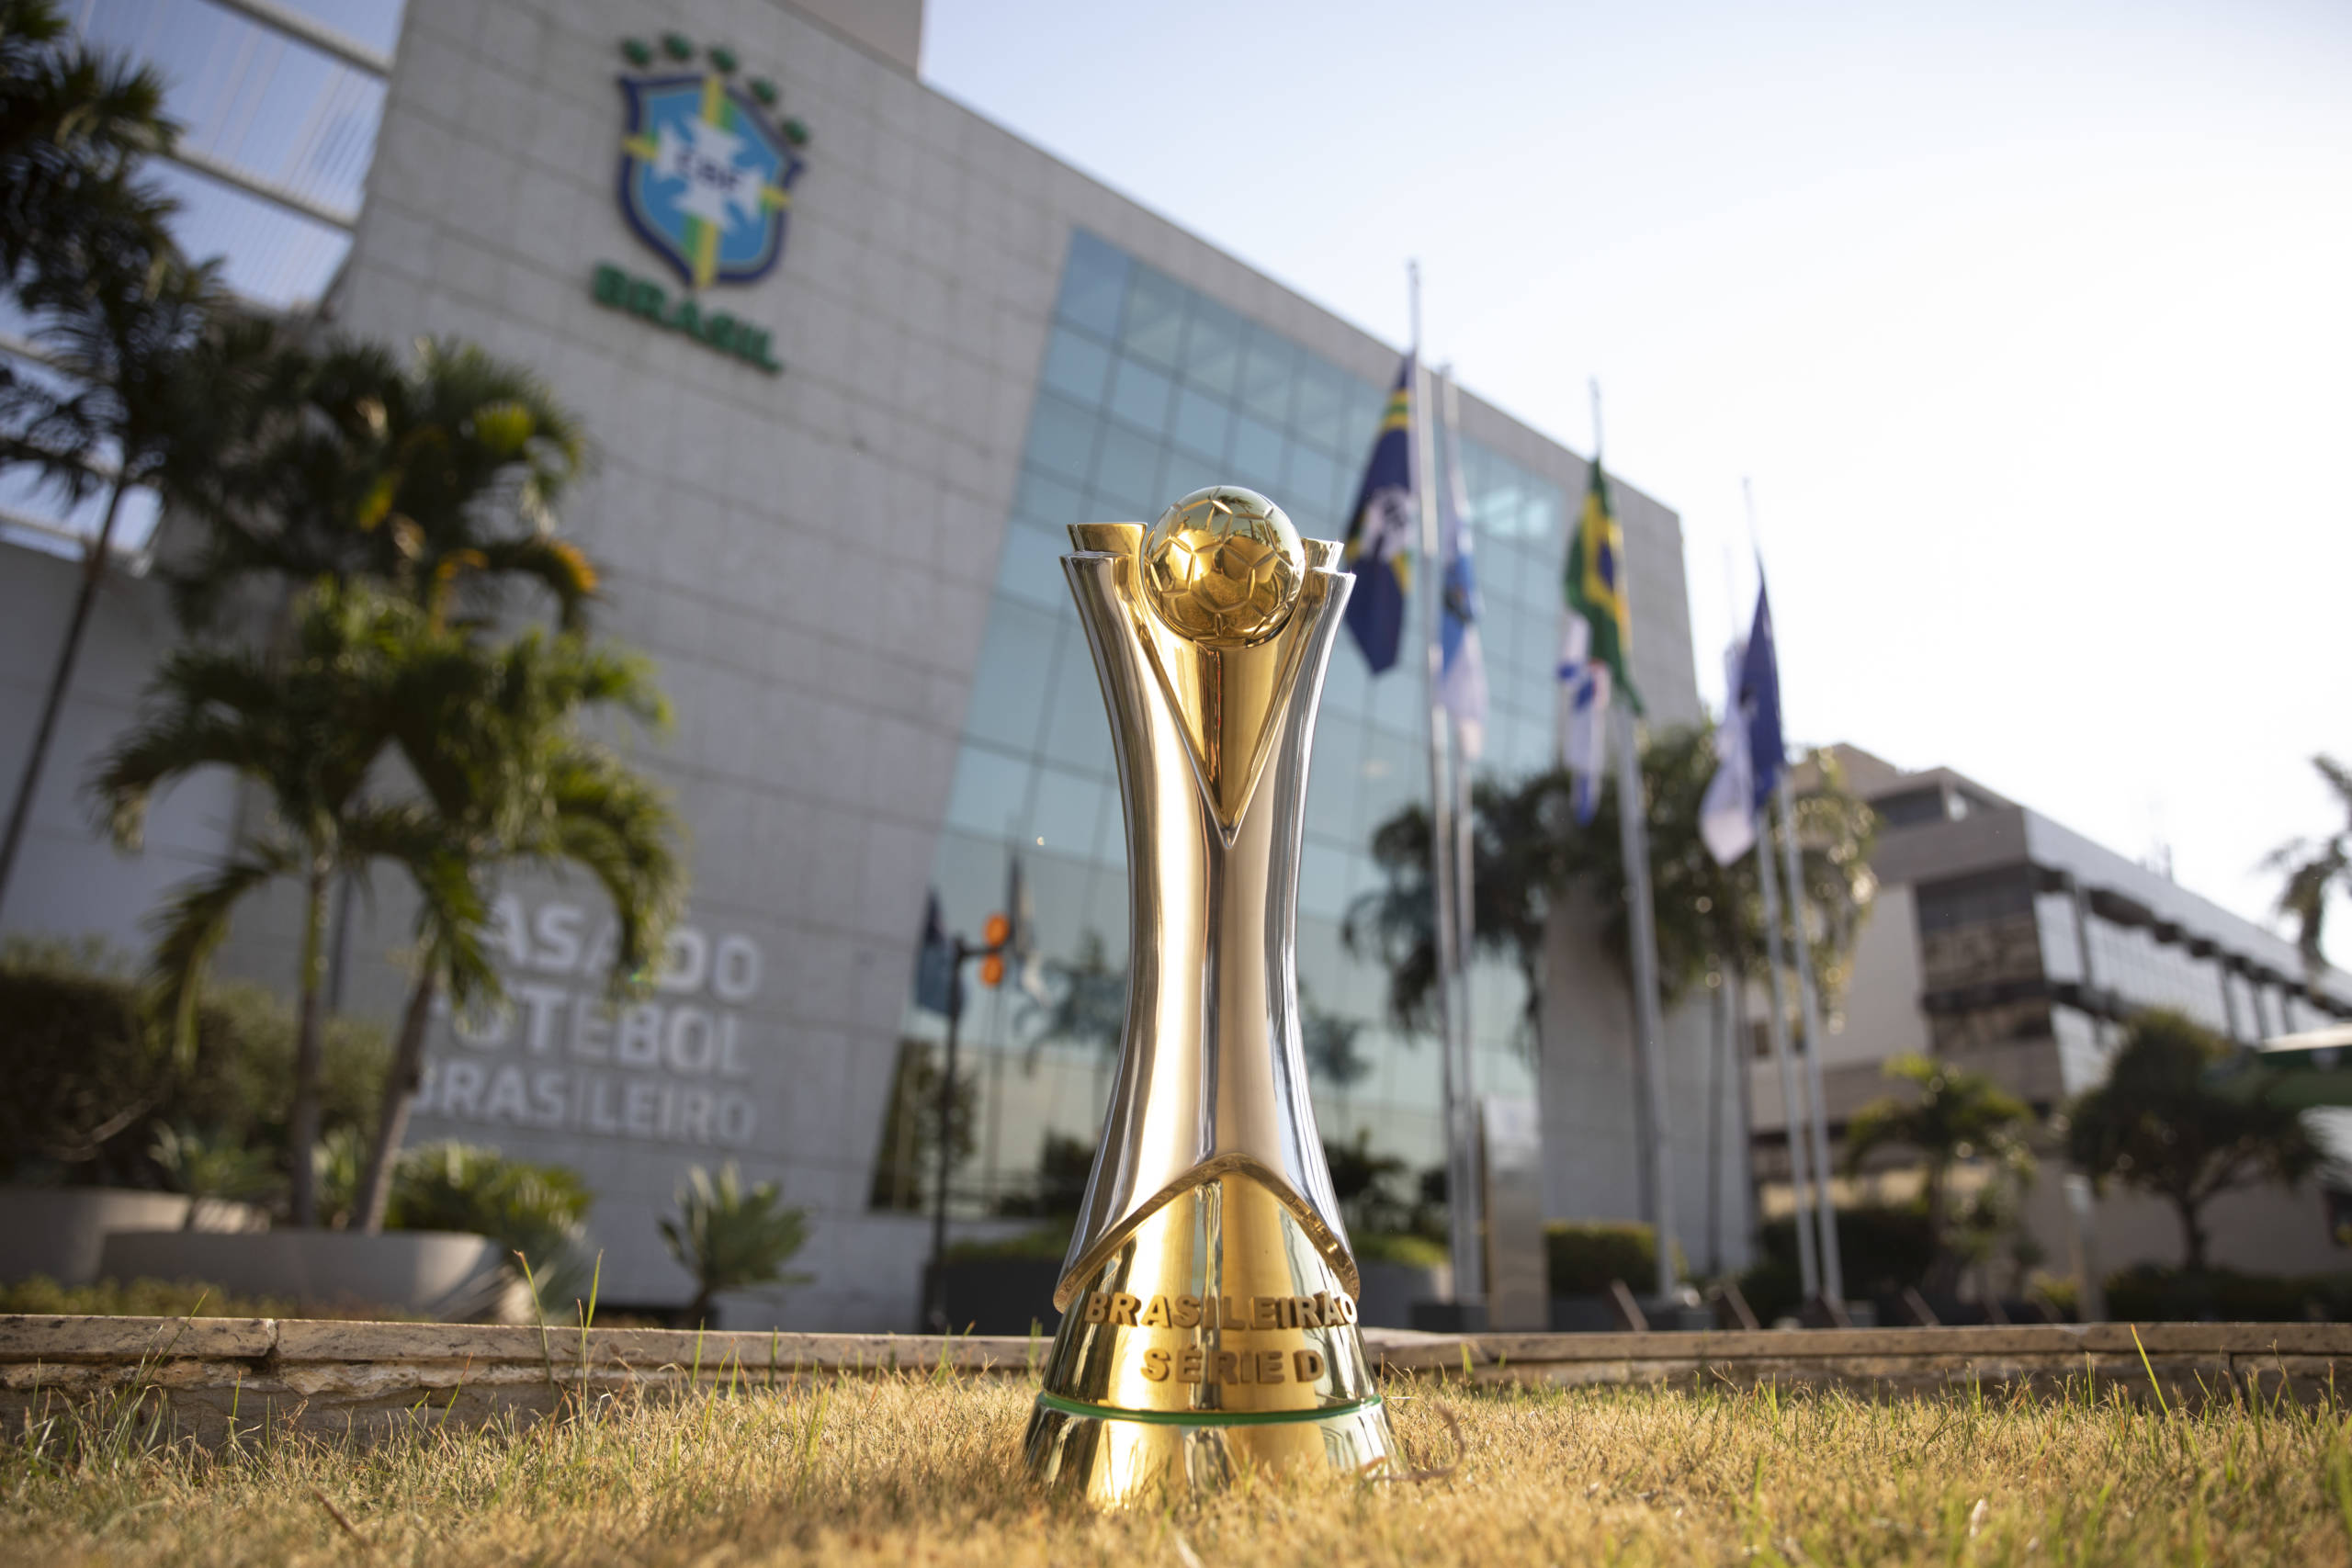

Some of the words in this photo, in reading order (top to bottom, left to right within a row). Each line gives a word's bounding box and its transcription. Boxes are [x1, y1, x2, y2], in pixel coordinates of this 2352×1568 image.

[591, 261, 783, 376] BRASIL
[1084, 1289, 1358, 1331] BRASILEIRÃO
[1141, 1344, 1284, 1385] SÉRIE
[1294, 1348, 1325, 1382] D
